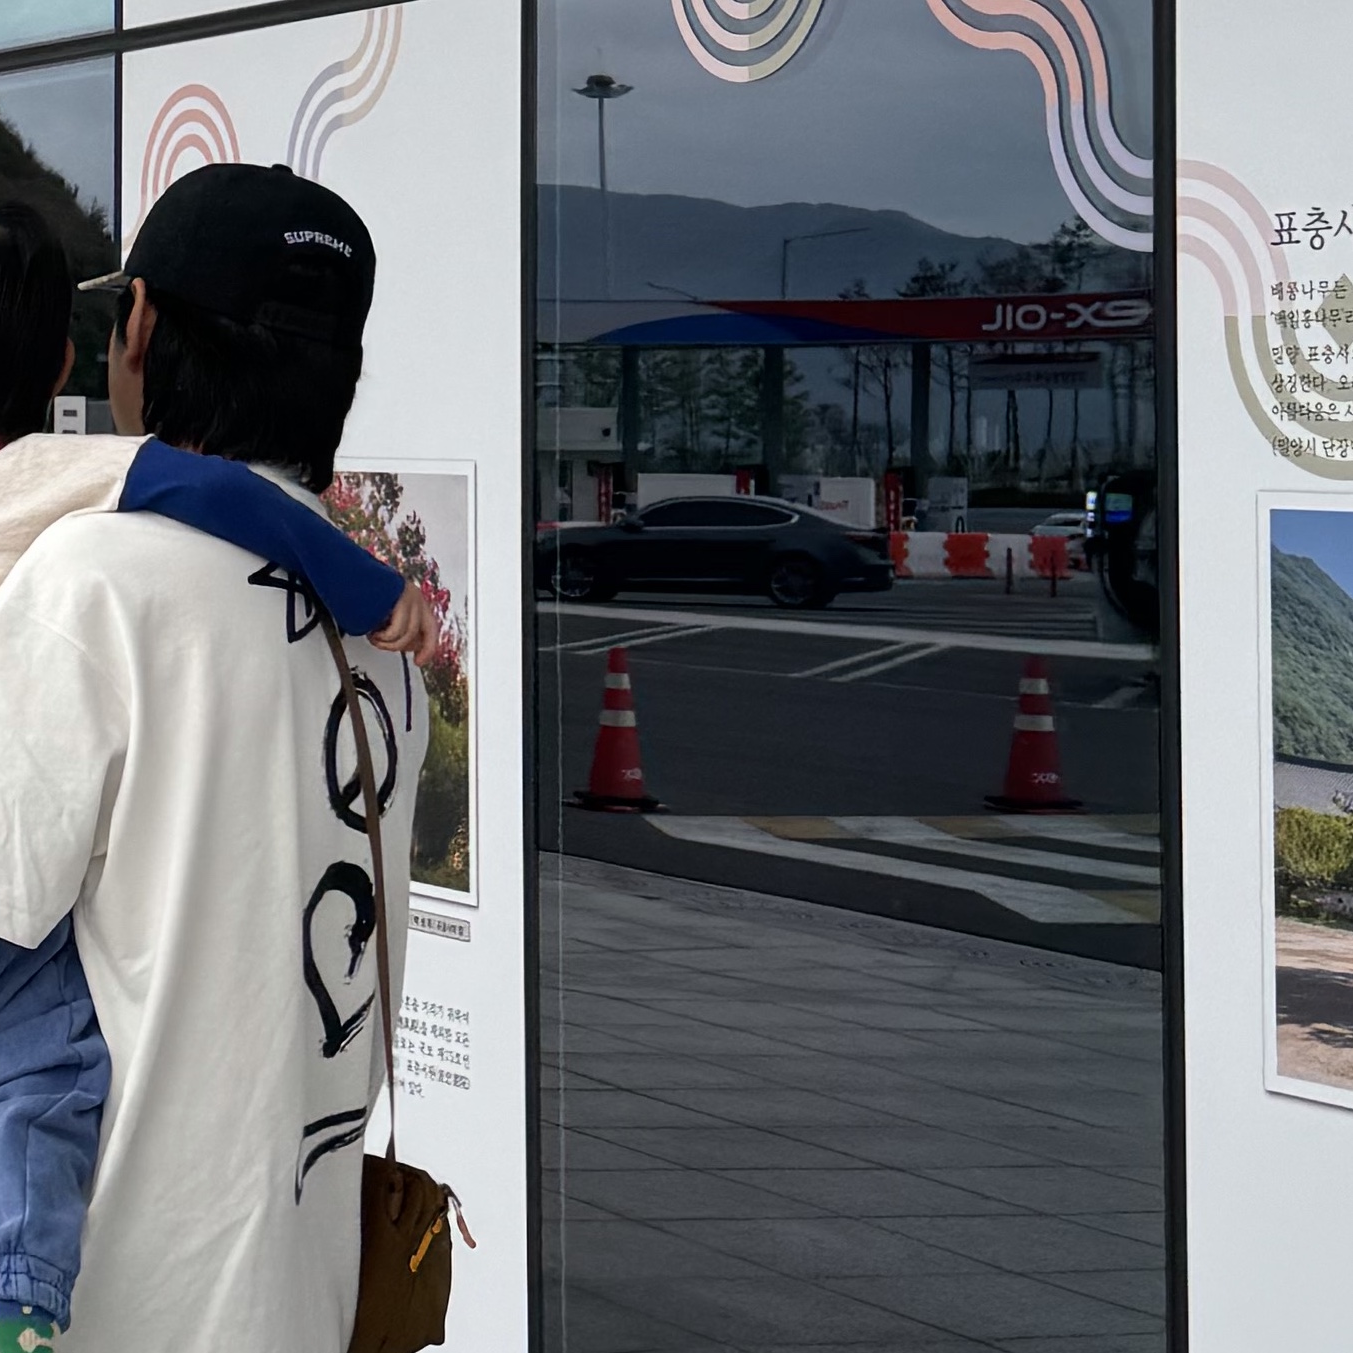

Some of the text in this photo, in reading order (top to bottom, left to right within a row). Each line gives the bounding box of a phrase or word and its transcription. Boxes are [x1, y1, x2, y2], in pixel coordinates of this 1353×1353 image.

[283, 230, 353, 258] SUPREME
[1306, 343, 1353, 364] 표충사
[1322, 436, 1353, 458] 단장
